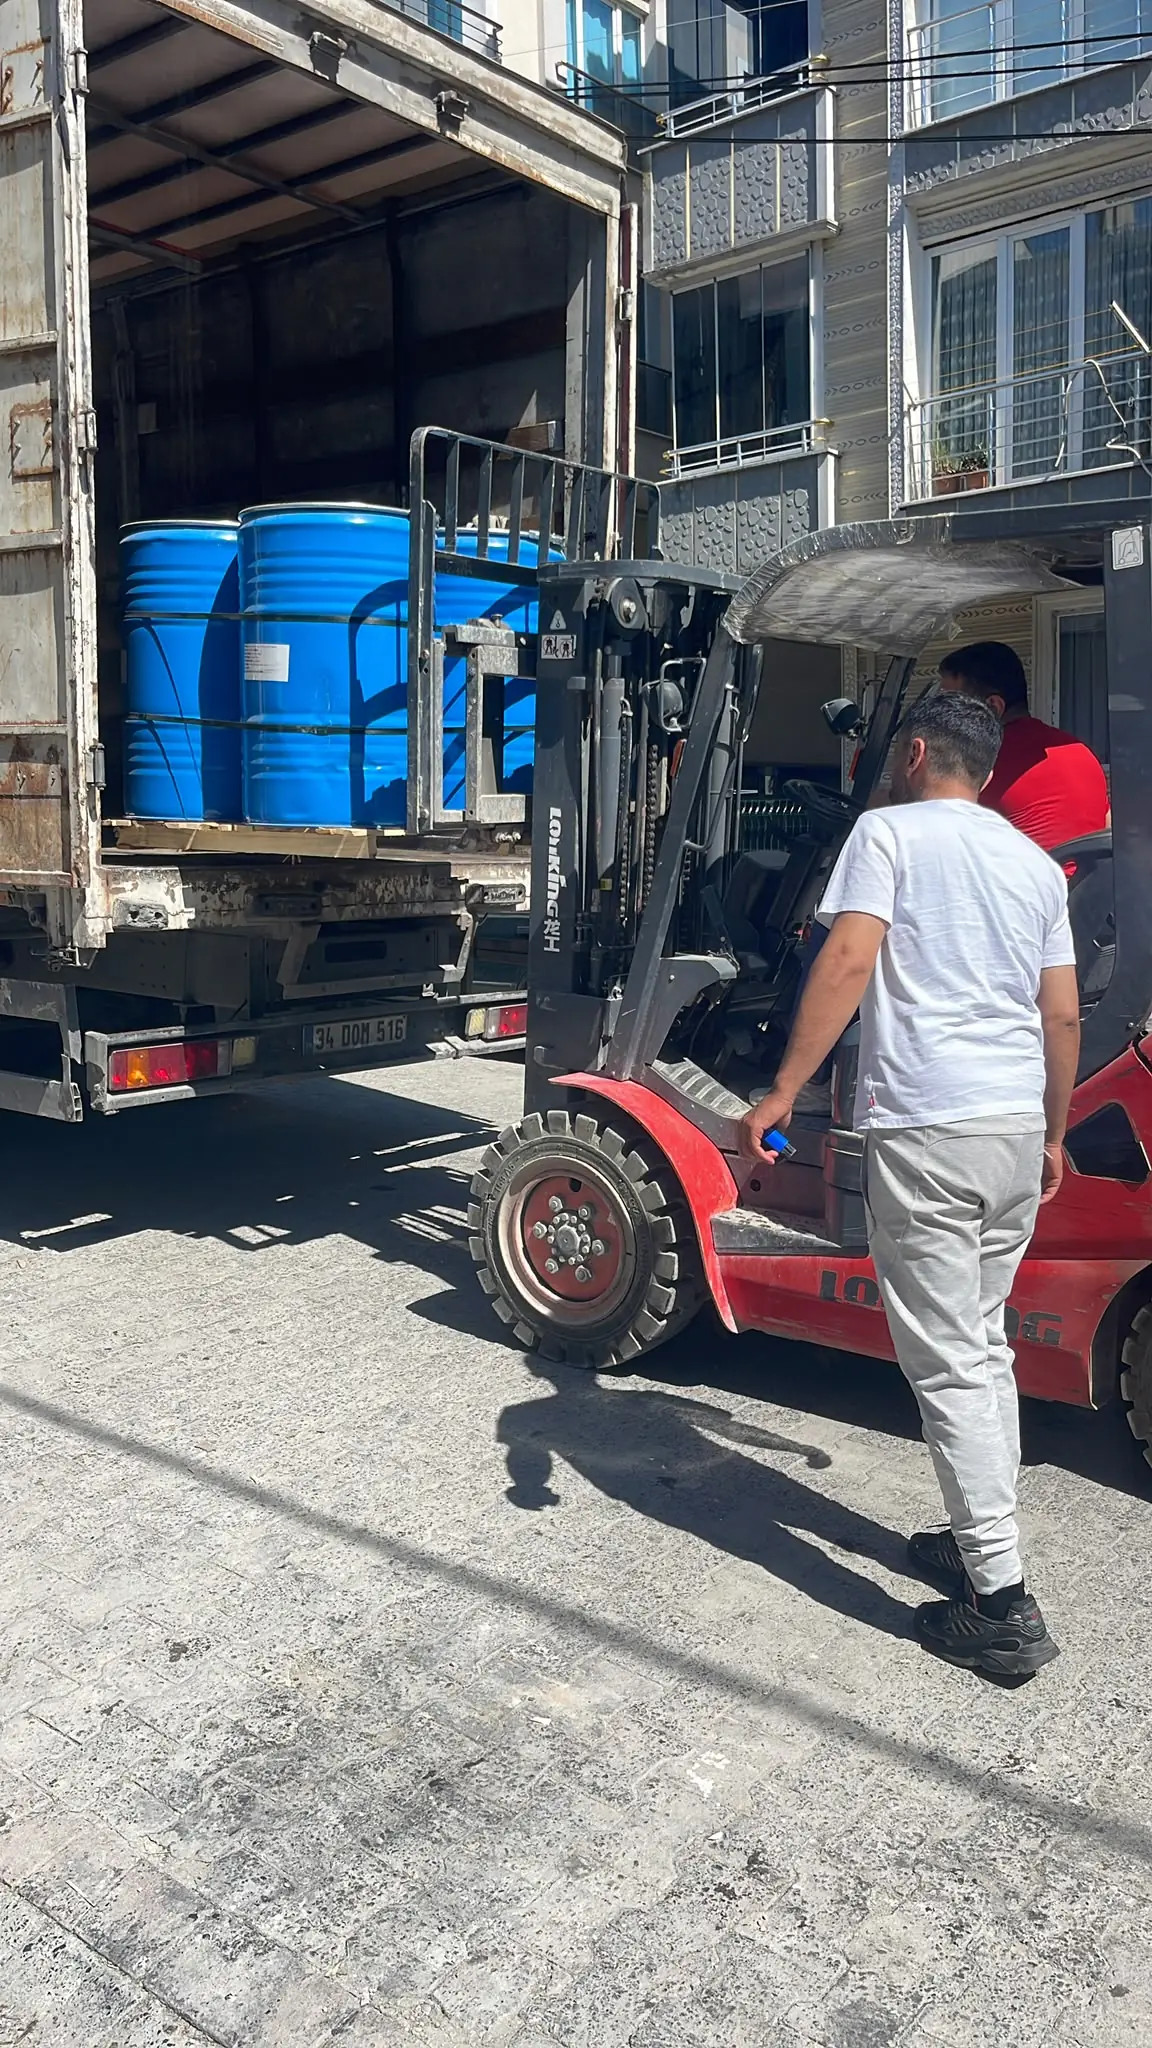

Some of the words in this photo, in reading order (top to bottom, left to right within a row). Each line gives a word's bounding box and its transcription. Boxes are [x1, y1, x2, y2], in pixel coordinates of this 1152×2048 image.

[315, 1026, 335, 1050] 34
[341, 1022, 371, 1047] DOM
[376, 1018, 405, 1042] 516
